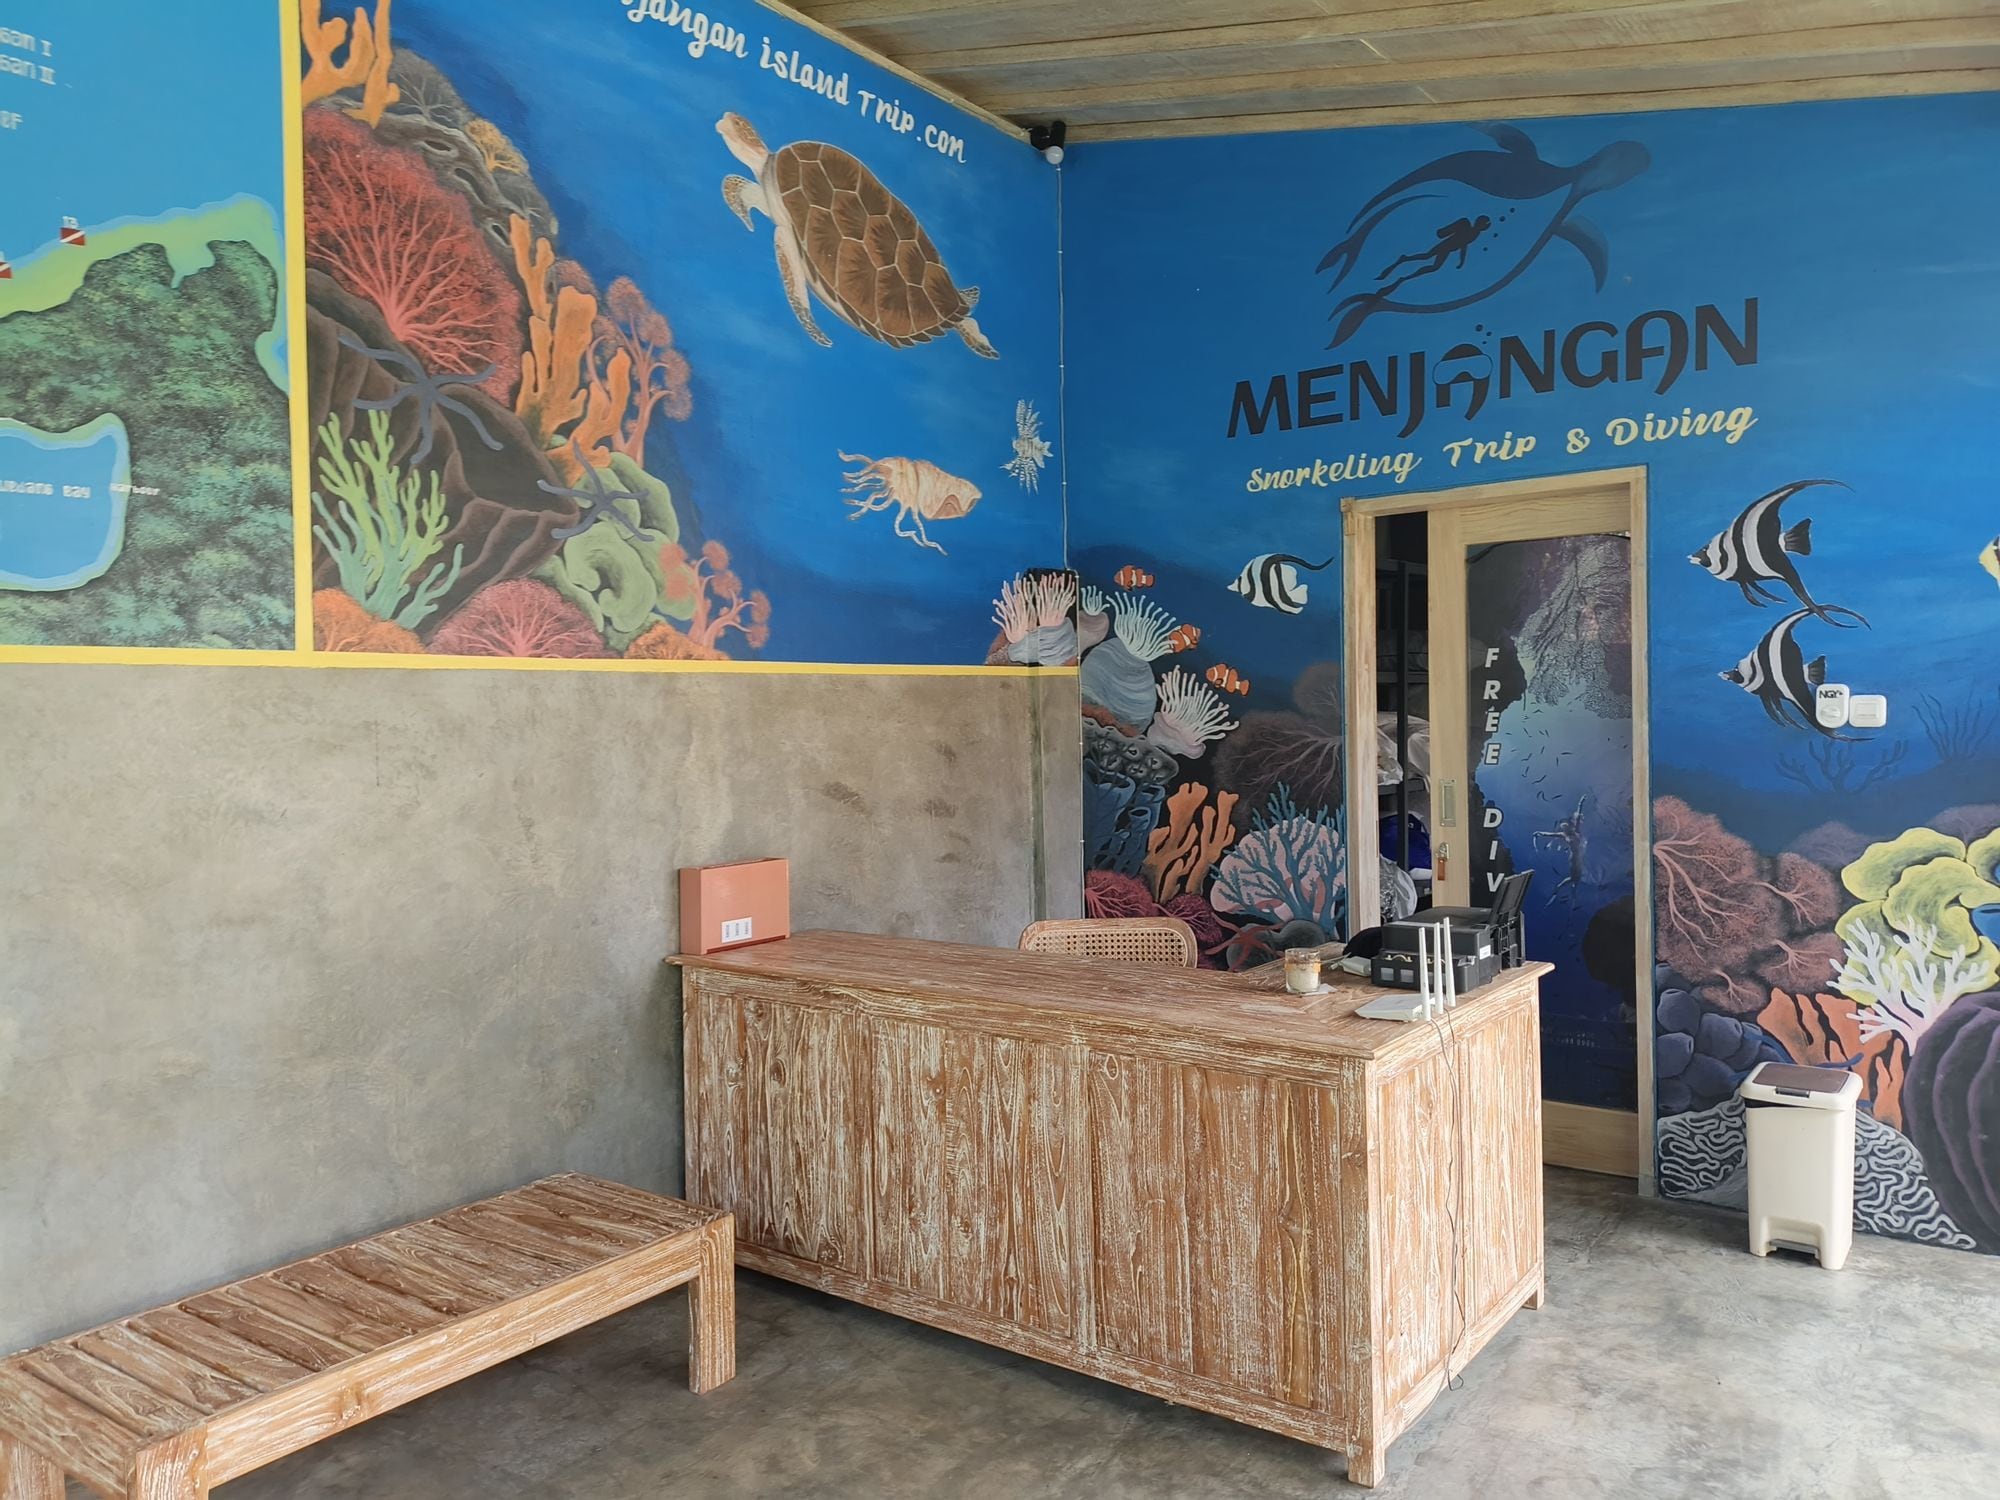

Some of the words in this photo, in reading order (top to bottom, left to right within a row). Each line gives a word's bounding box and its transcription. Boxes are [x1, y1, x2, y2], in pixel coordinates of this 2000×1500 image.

[620, 0, 749, 58] jangan
[760, 37, 849, 105] island
[1227, 297, 1759, 438] MENJANGAN
[1246, 450, 1422, 493] Snorkeling
[1442, 430, 1537, 468] Trip
[1566, 427, 1591, 455] &
[1606, 405, 1759, 445] Diving
[1482, 647, 1501, 766] FREE
